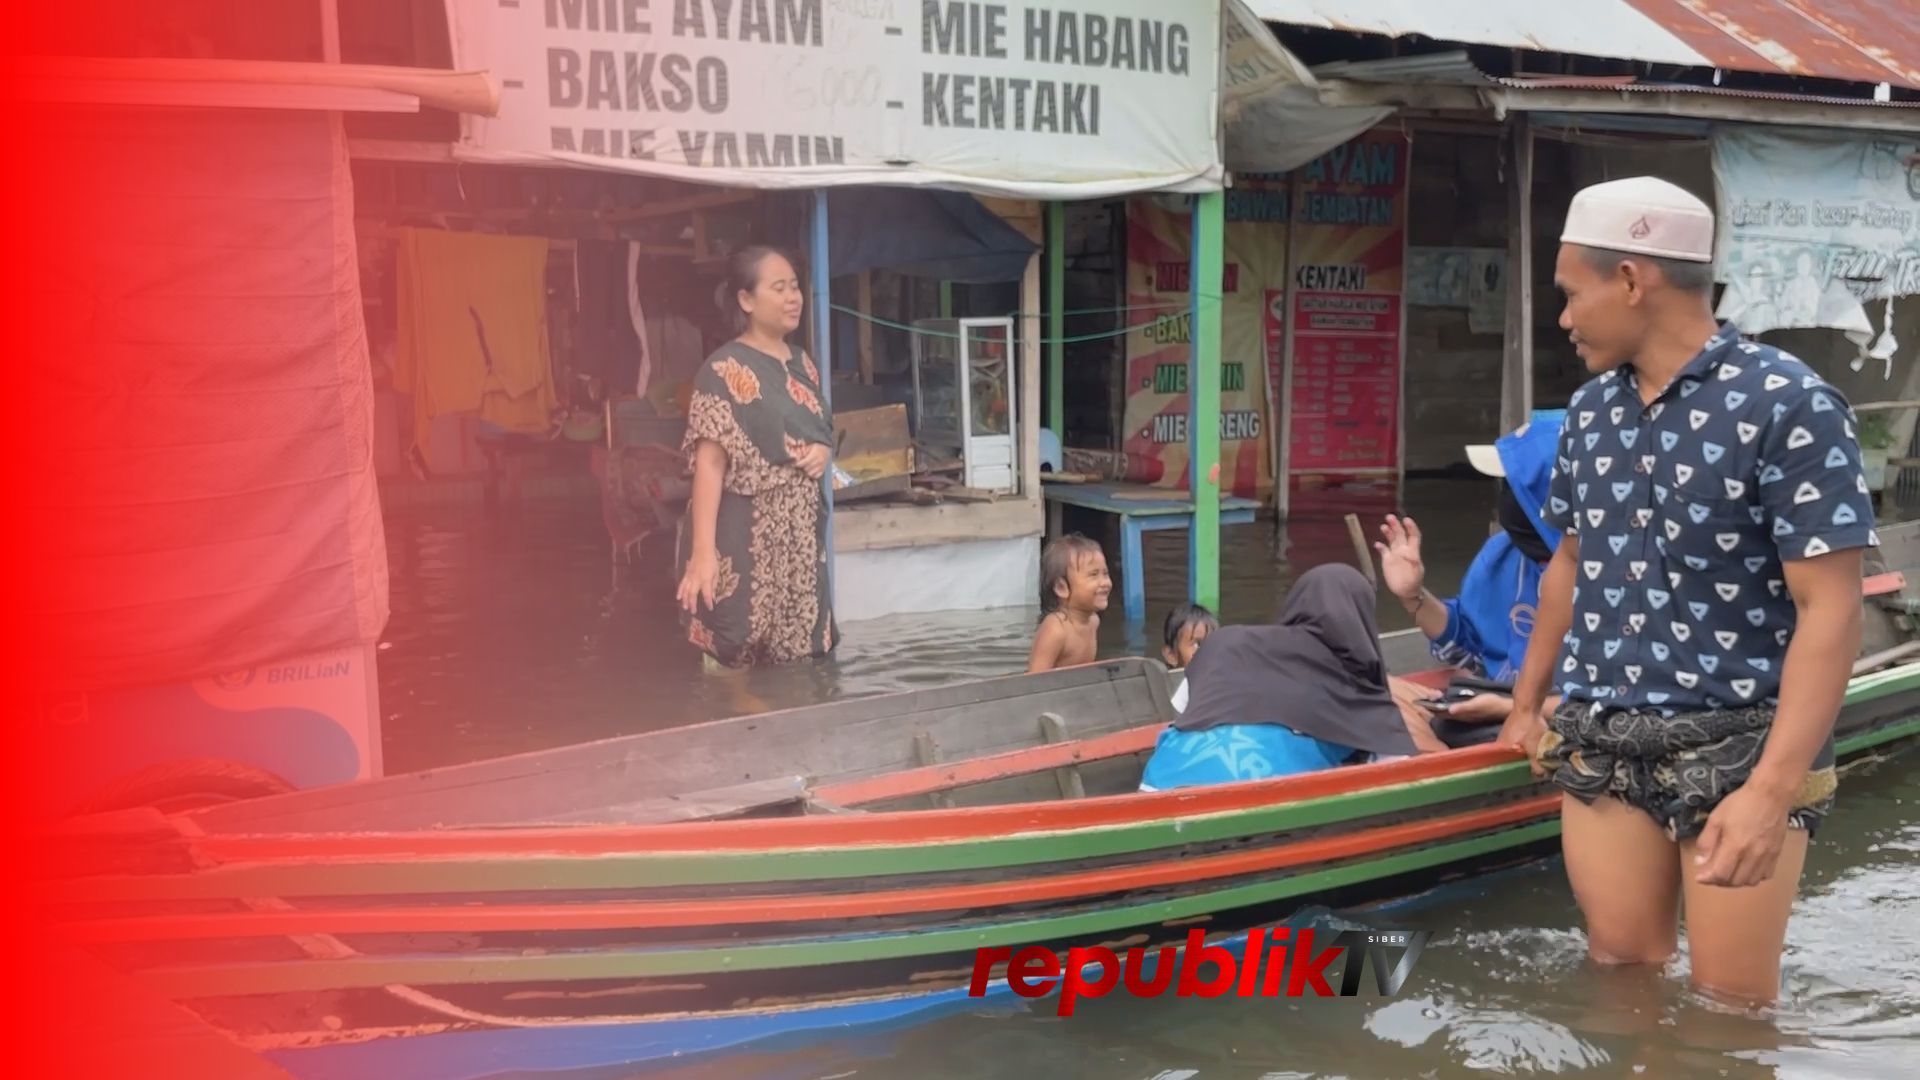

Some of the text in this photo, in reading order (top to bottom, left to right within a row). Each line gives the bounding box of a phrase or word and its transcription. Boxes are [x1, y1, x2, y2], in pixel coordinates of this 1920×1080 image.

[672, 0, 824, 47] AYAM
[922, 0, 1007, 59] MIE
[1024, 8, 1190, 77] HABANG
[546, 47, 730, 114] BAKSO
[922, 72, 1100, 136] KENTAKI
[1304, 142, 1397, 185] AYAM
[1296, 264, 1366, 291] KENTAKI
[1155, 312, 1191, 344] BAK
[1154, 363, 1187, 394] MIE
[1153, 413, 1187, 444] MIE
[267, 660, 350, 684] BRILiaN
